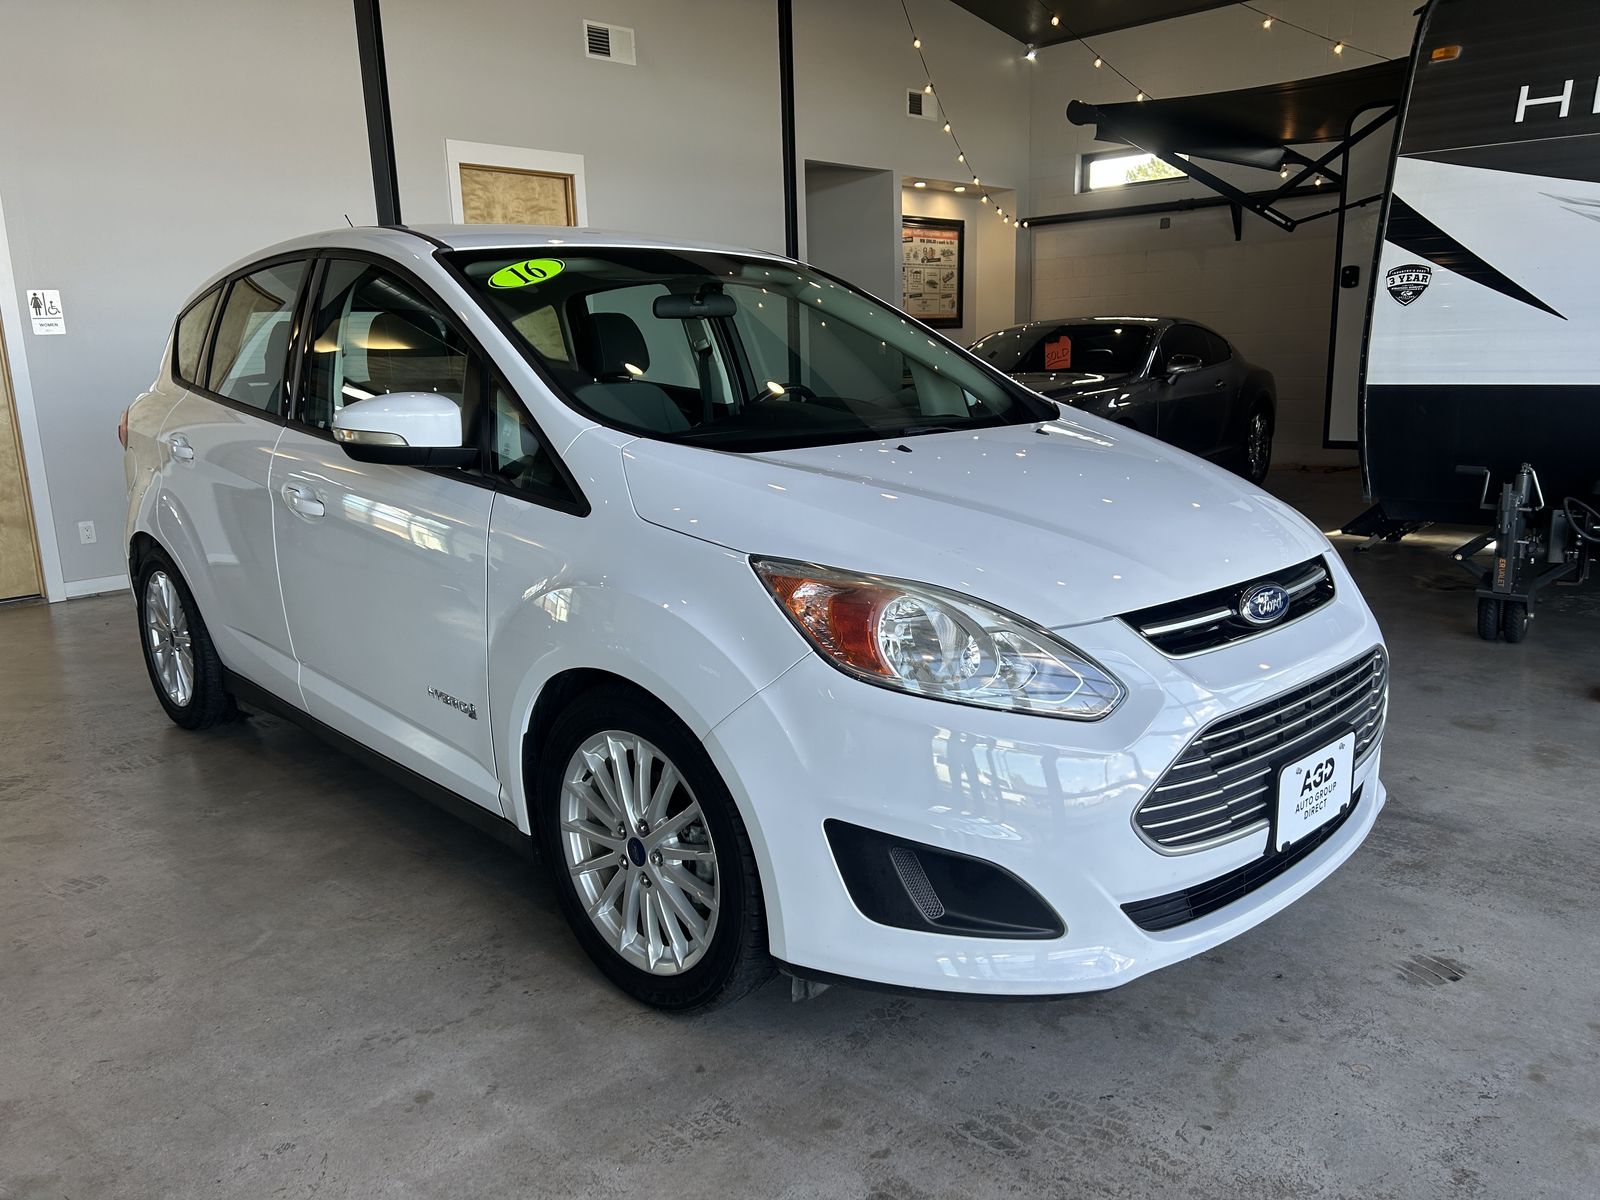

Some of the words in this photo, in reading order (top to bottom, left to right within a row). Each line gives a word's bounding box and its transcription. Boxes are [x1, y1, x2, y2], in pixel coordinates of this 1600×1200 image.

[506, 261, 547, 285] 16
[1389, 277, 1396, 286] 3
[1398, 274, 1429, 283] YEAR
[1046, 347, 1070, 364] SOLD
[1256, 590, 1284, 615] Ford
[1300, 757, 1335, 797] AGD
[1295, 796, 1314, 814] AUTO
[1315, 781, 1337, 802] GROUP
[1304, 798, 1328, 820] DIRECT
